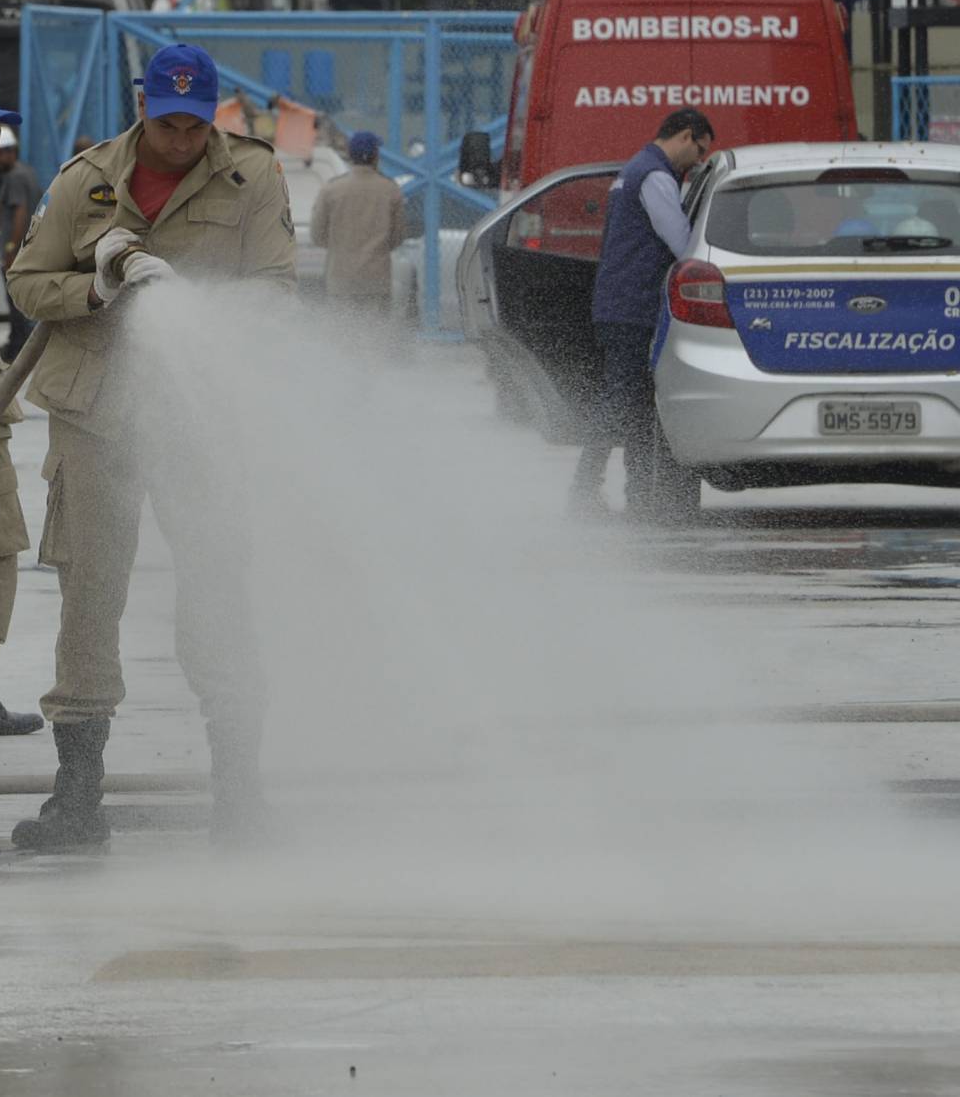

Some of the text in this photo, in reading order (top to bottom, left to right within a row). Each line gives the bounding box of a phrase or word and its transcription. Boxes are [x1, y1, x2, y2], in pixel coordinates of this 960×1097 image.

[572, 15, 799, 41] BOMBEIROS-RJ
[574, 85, 810, 107] ABASTECIMENTO
[743, 288, 835, 300] (21) 2179-2007
[784, 328, 956, 354] FISCALIZAÇÃO
